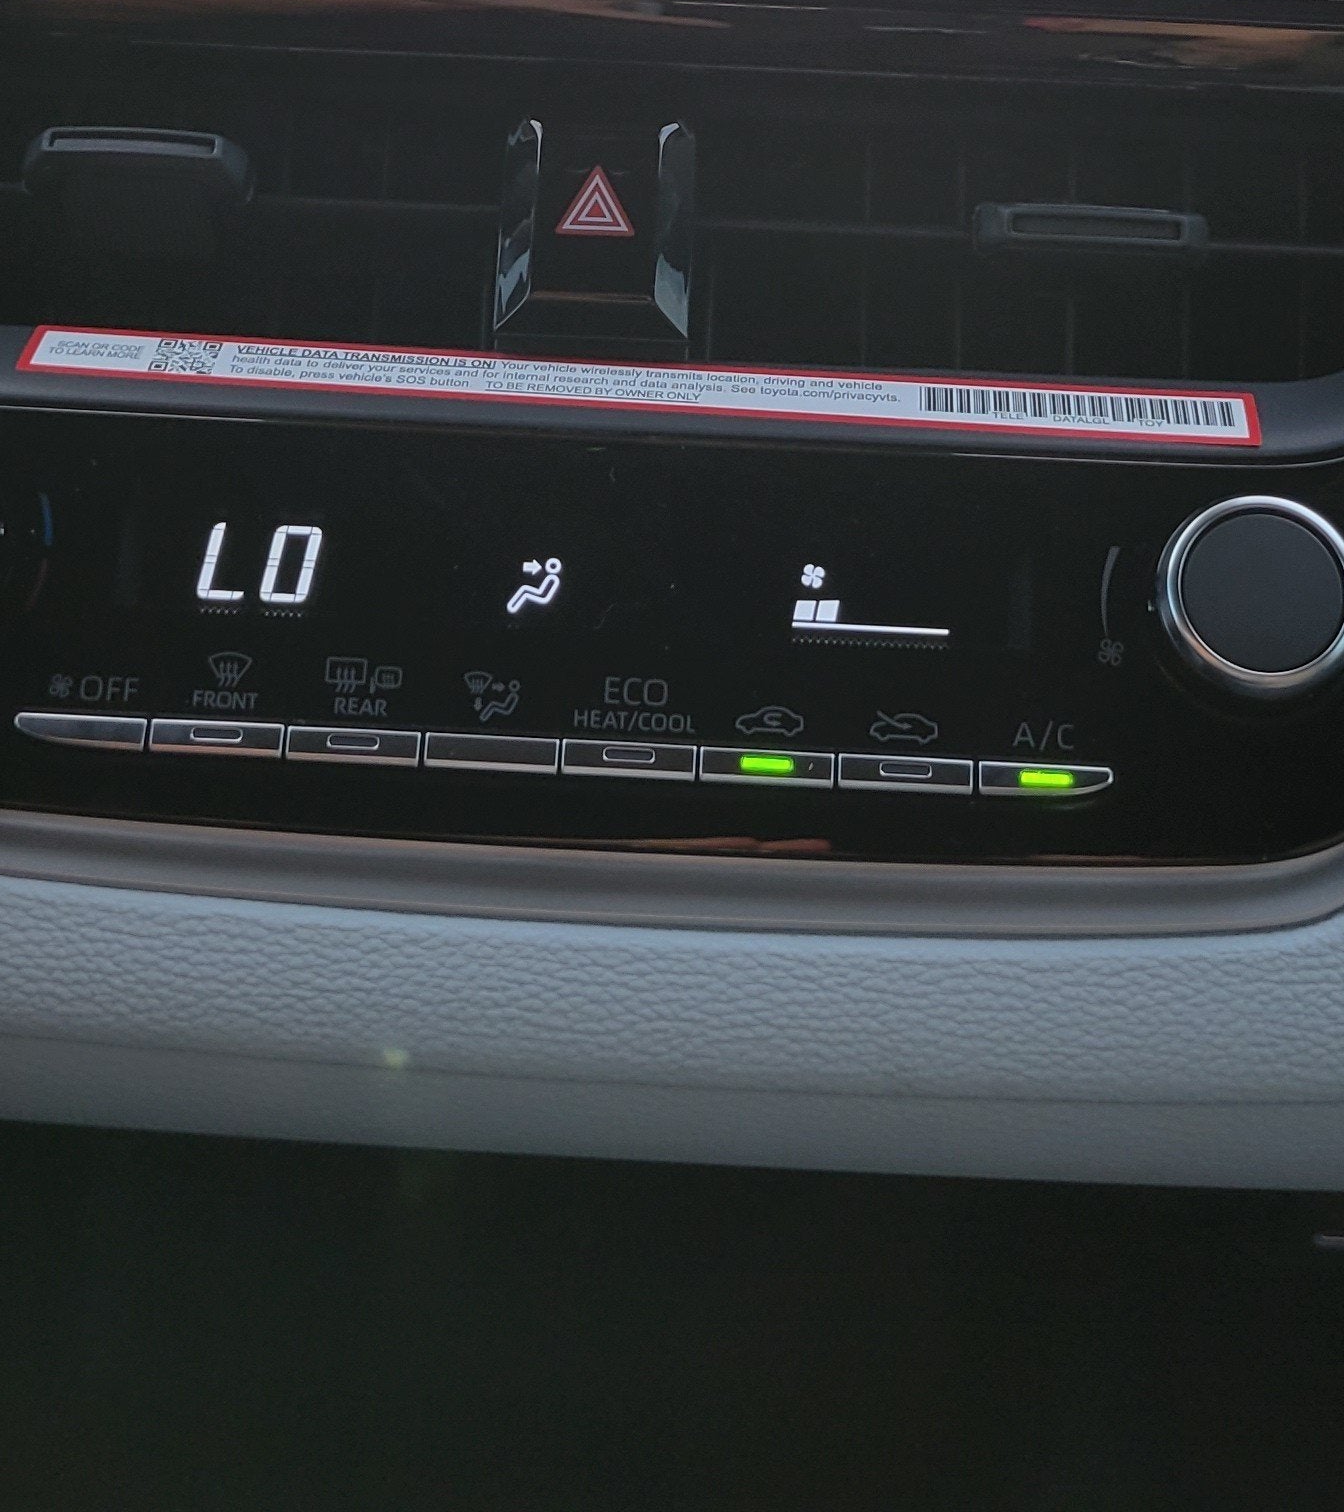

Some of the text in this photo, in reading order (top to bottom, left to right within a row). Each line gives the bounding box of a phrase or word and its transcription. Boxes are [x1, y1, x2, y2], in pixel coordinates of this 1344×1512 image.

[48, 346, 142, 360] TO LEARN MORE
[57, 340, 90, 350] SCAN
[111, 344, 147, 353] CODE
[230, 364, 469, 388] To disable, press vehicle's SOS button
[231, 354, 271, 365] health
[275, 357, 302, 367] data
[306, 359, 319, 368] to
[323, 360, 365, 371] deliver
[367, 364, 397, 374] your
[399, 365, 451, 376] services
[454, 368, 478, 378] and
[482, 370, 500, 379] for
[503, 371, 550, 383] internal
[554, 374, 608, 386] research
[613, 377, 636, 387] and
[640, 379, 667, 389] data
[671, 381, 726, 393] analysis.
[731, 384, 756, 394] See
[237, 344, 299, 356] VEHICLE
[301, 349, 337, 359] DATA
[339, 350, 453, 367] TRANSMISSION
[454, 358, 468, 368] IS
[502, 361, 532, 371] Your
[533, 362, 577, 373] vehicle
[581, 365, 642, 379] wirelessly
[646, 369, 704, 381] transmits
[763, 377, 805, 389] driving
[809, 379, 834, 388] and
[837, 380, 883, 391] vehicle
[485, 381, 702, 402] TO BE REMOVED BY OWNER ONLY
[80, 674, 140, 702] OFF
[191, 690, 259, 710] FRONT
[604, 676, 669, 707] ECO
[333, 696, 388, 718] REAR
[573, 708, 696, 734] HEAT/COOL
[1012, 719, 1075, 751] A/C
